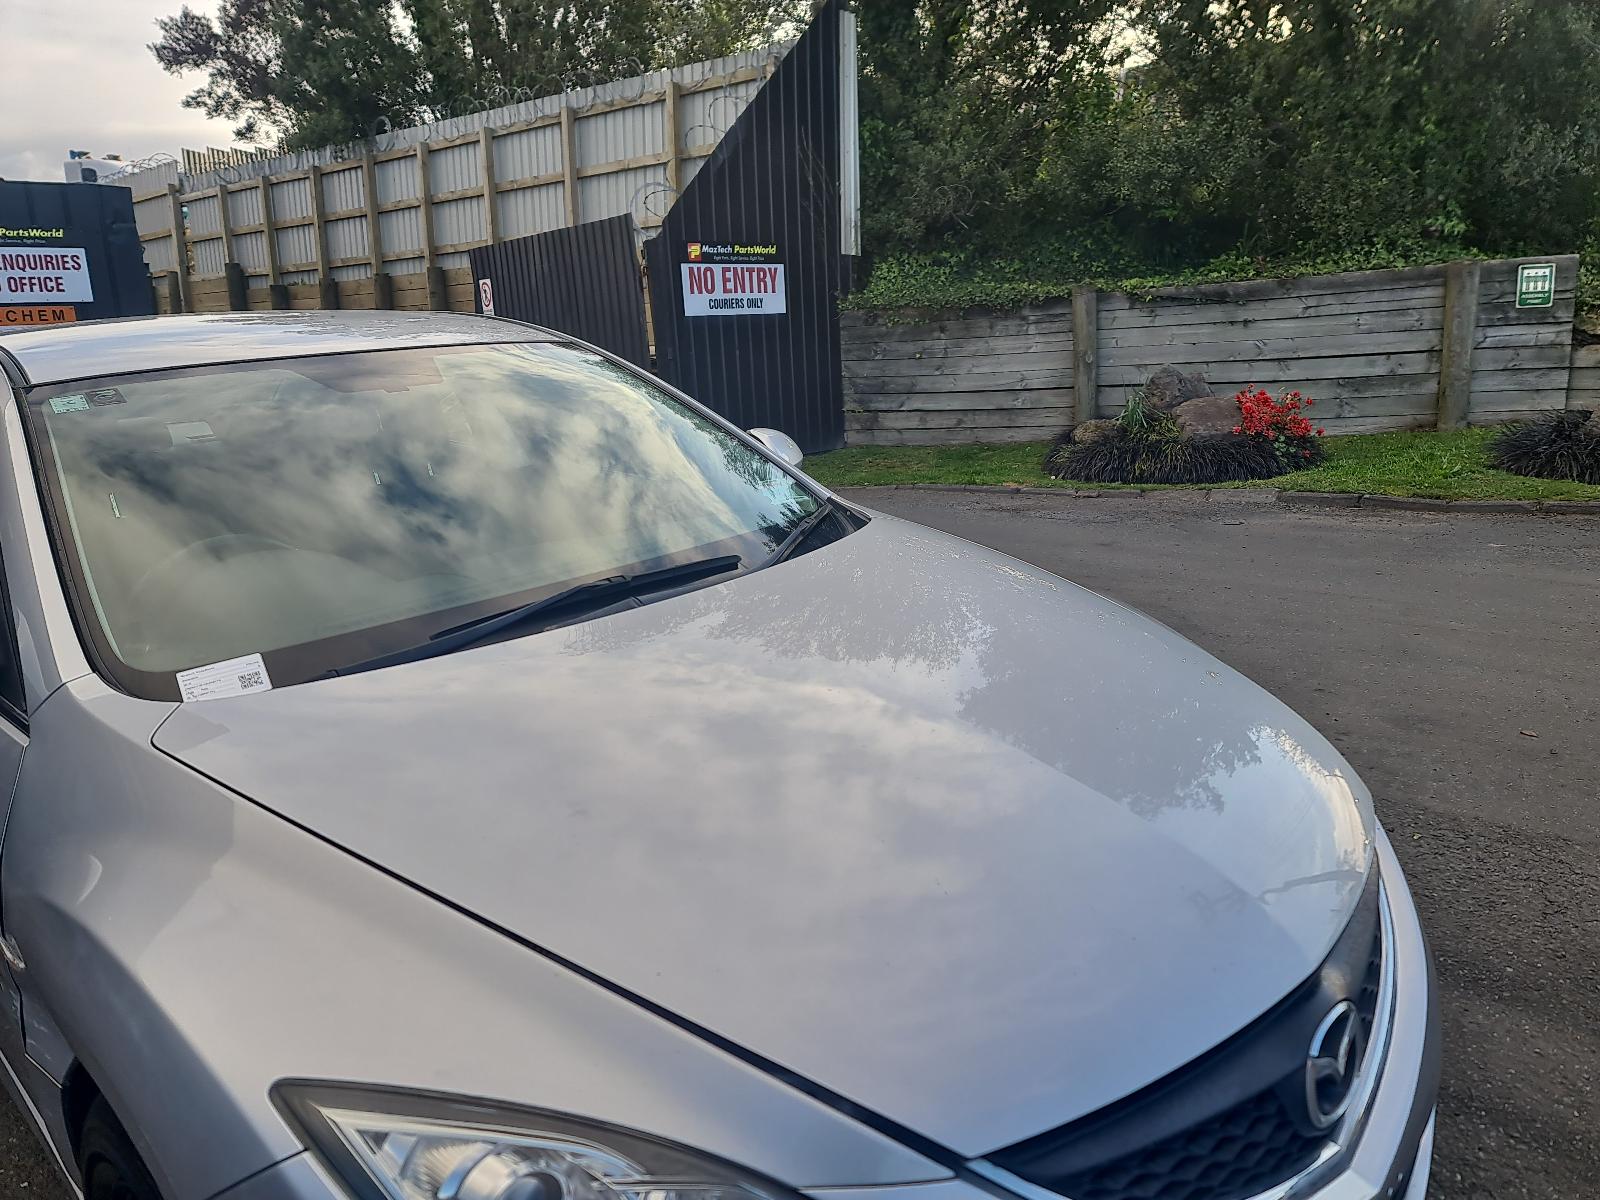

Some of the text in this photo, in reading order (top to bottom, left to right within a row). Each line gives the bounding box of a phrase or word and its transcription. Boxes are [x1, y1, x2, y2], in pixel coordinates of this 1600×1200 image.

[0, 227, 64, 238] PartsWorld
[734, 245, 777, 255] PartsWorld
[0, 253, 82, 273] NQUIRIES
[7, 276, 66, 293] OFFICE
[688, 266, 778, 295] NO ENTRY
[708, 297, 764, 310] COURIERS ONLY
[0, 308, 66, 323] CHEM
